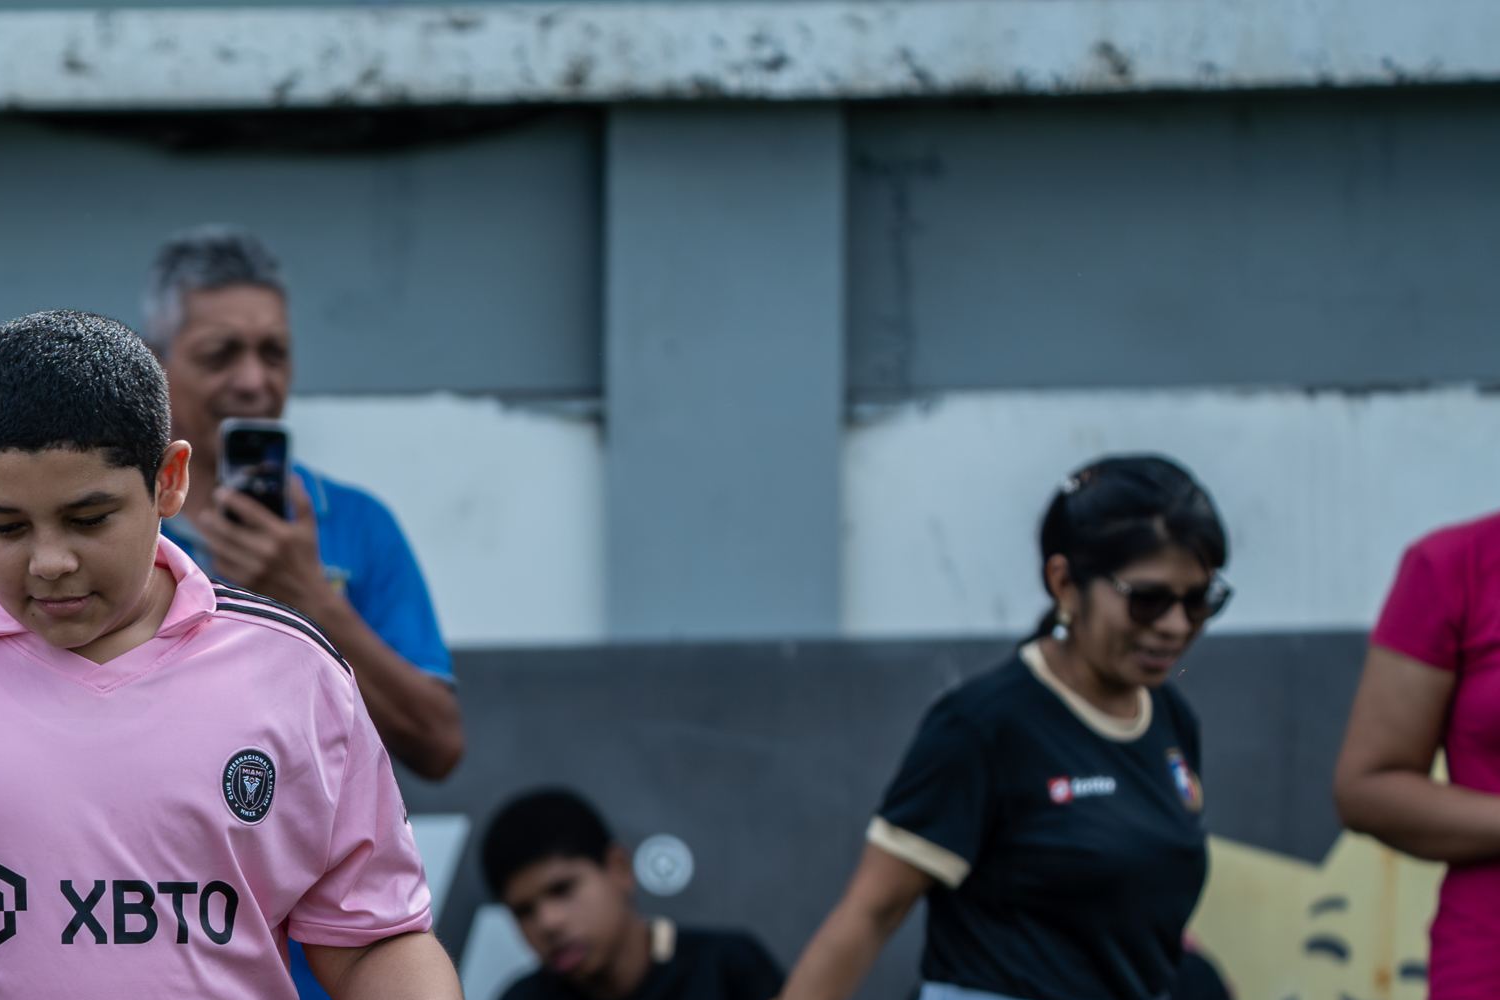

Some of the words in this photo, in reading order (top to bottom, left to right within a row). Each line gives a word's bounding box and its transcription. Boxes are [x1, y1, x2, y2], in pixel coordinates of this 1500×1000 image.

[227, 755, 270, 779] INTERNACIONAL
[242, 768, 264, 777] MIAMI
[226, 781, 234, 800] CLUB
[60, 879, 239, 945] XBTO
